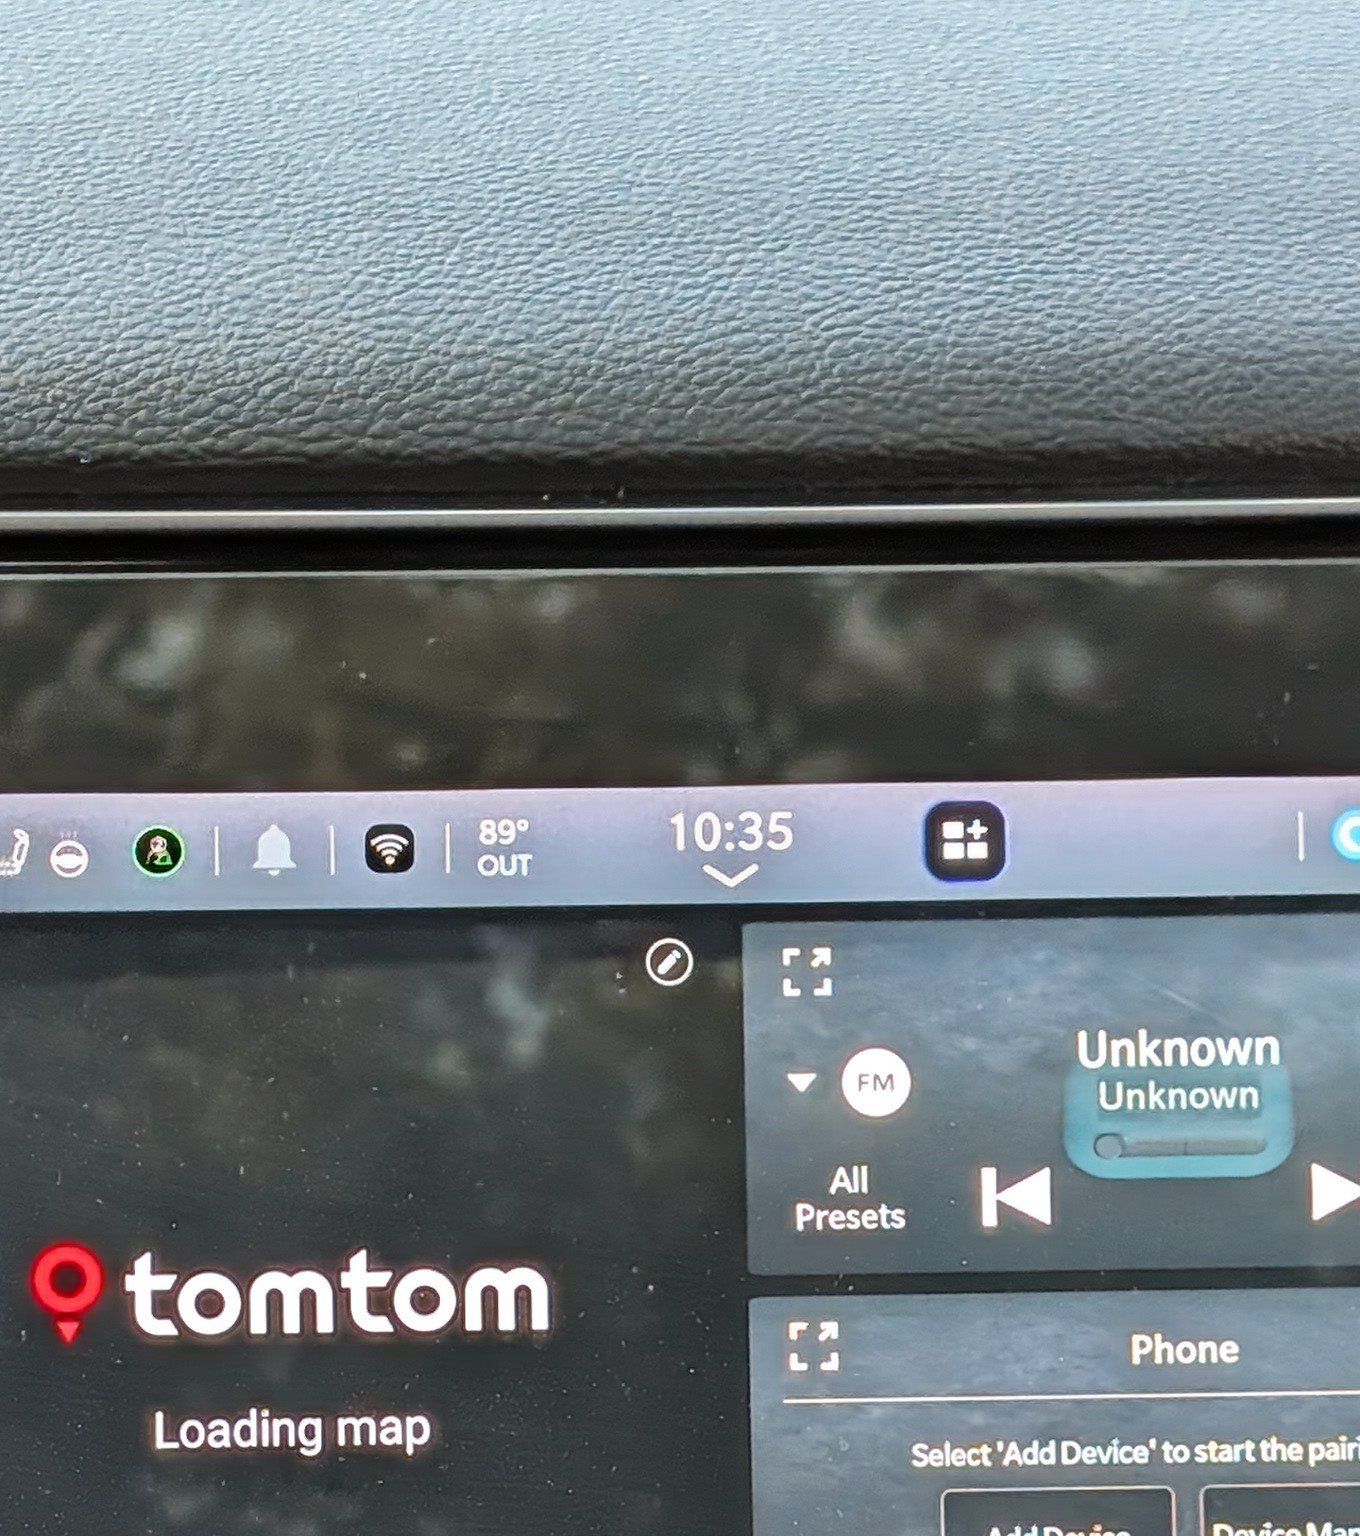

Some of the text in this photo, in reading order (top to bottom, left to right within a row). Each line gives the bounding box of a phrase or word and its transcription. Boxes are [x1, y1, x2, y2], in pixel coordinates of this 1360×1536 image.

[478, 818, 530, 846] 89°
[669, 811, 794, 852] 10:35
[477, 852, 533, 879] OUT
[1077, 1026, 1281, 1070] Unknown
[858, 1072, 896, 1094] FM
[1097, 1078, 1260, 1114] Unknown
[829, 1165, 869, 1197] All
[795, 1201, 907, 1231] Presets
[124, 1246, 551, 1337] tomtom
[1130, 1332, 1240, 1366] Phone
[154, 1407, 431, 1457] Loading map
[911, 1440, 992, 1468] Select
[1162, 1440, 1190, 1464] to
[1194, 1440, 1256, 1463] start
[1260, 1435, 1303, 1462] the
